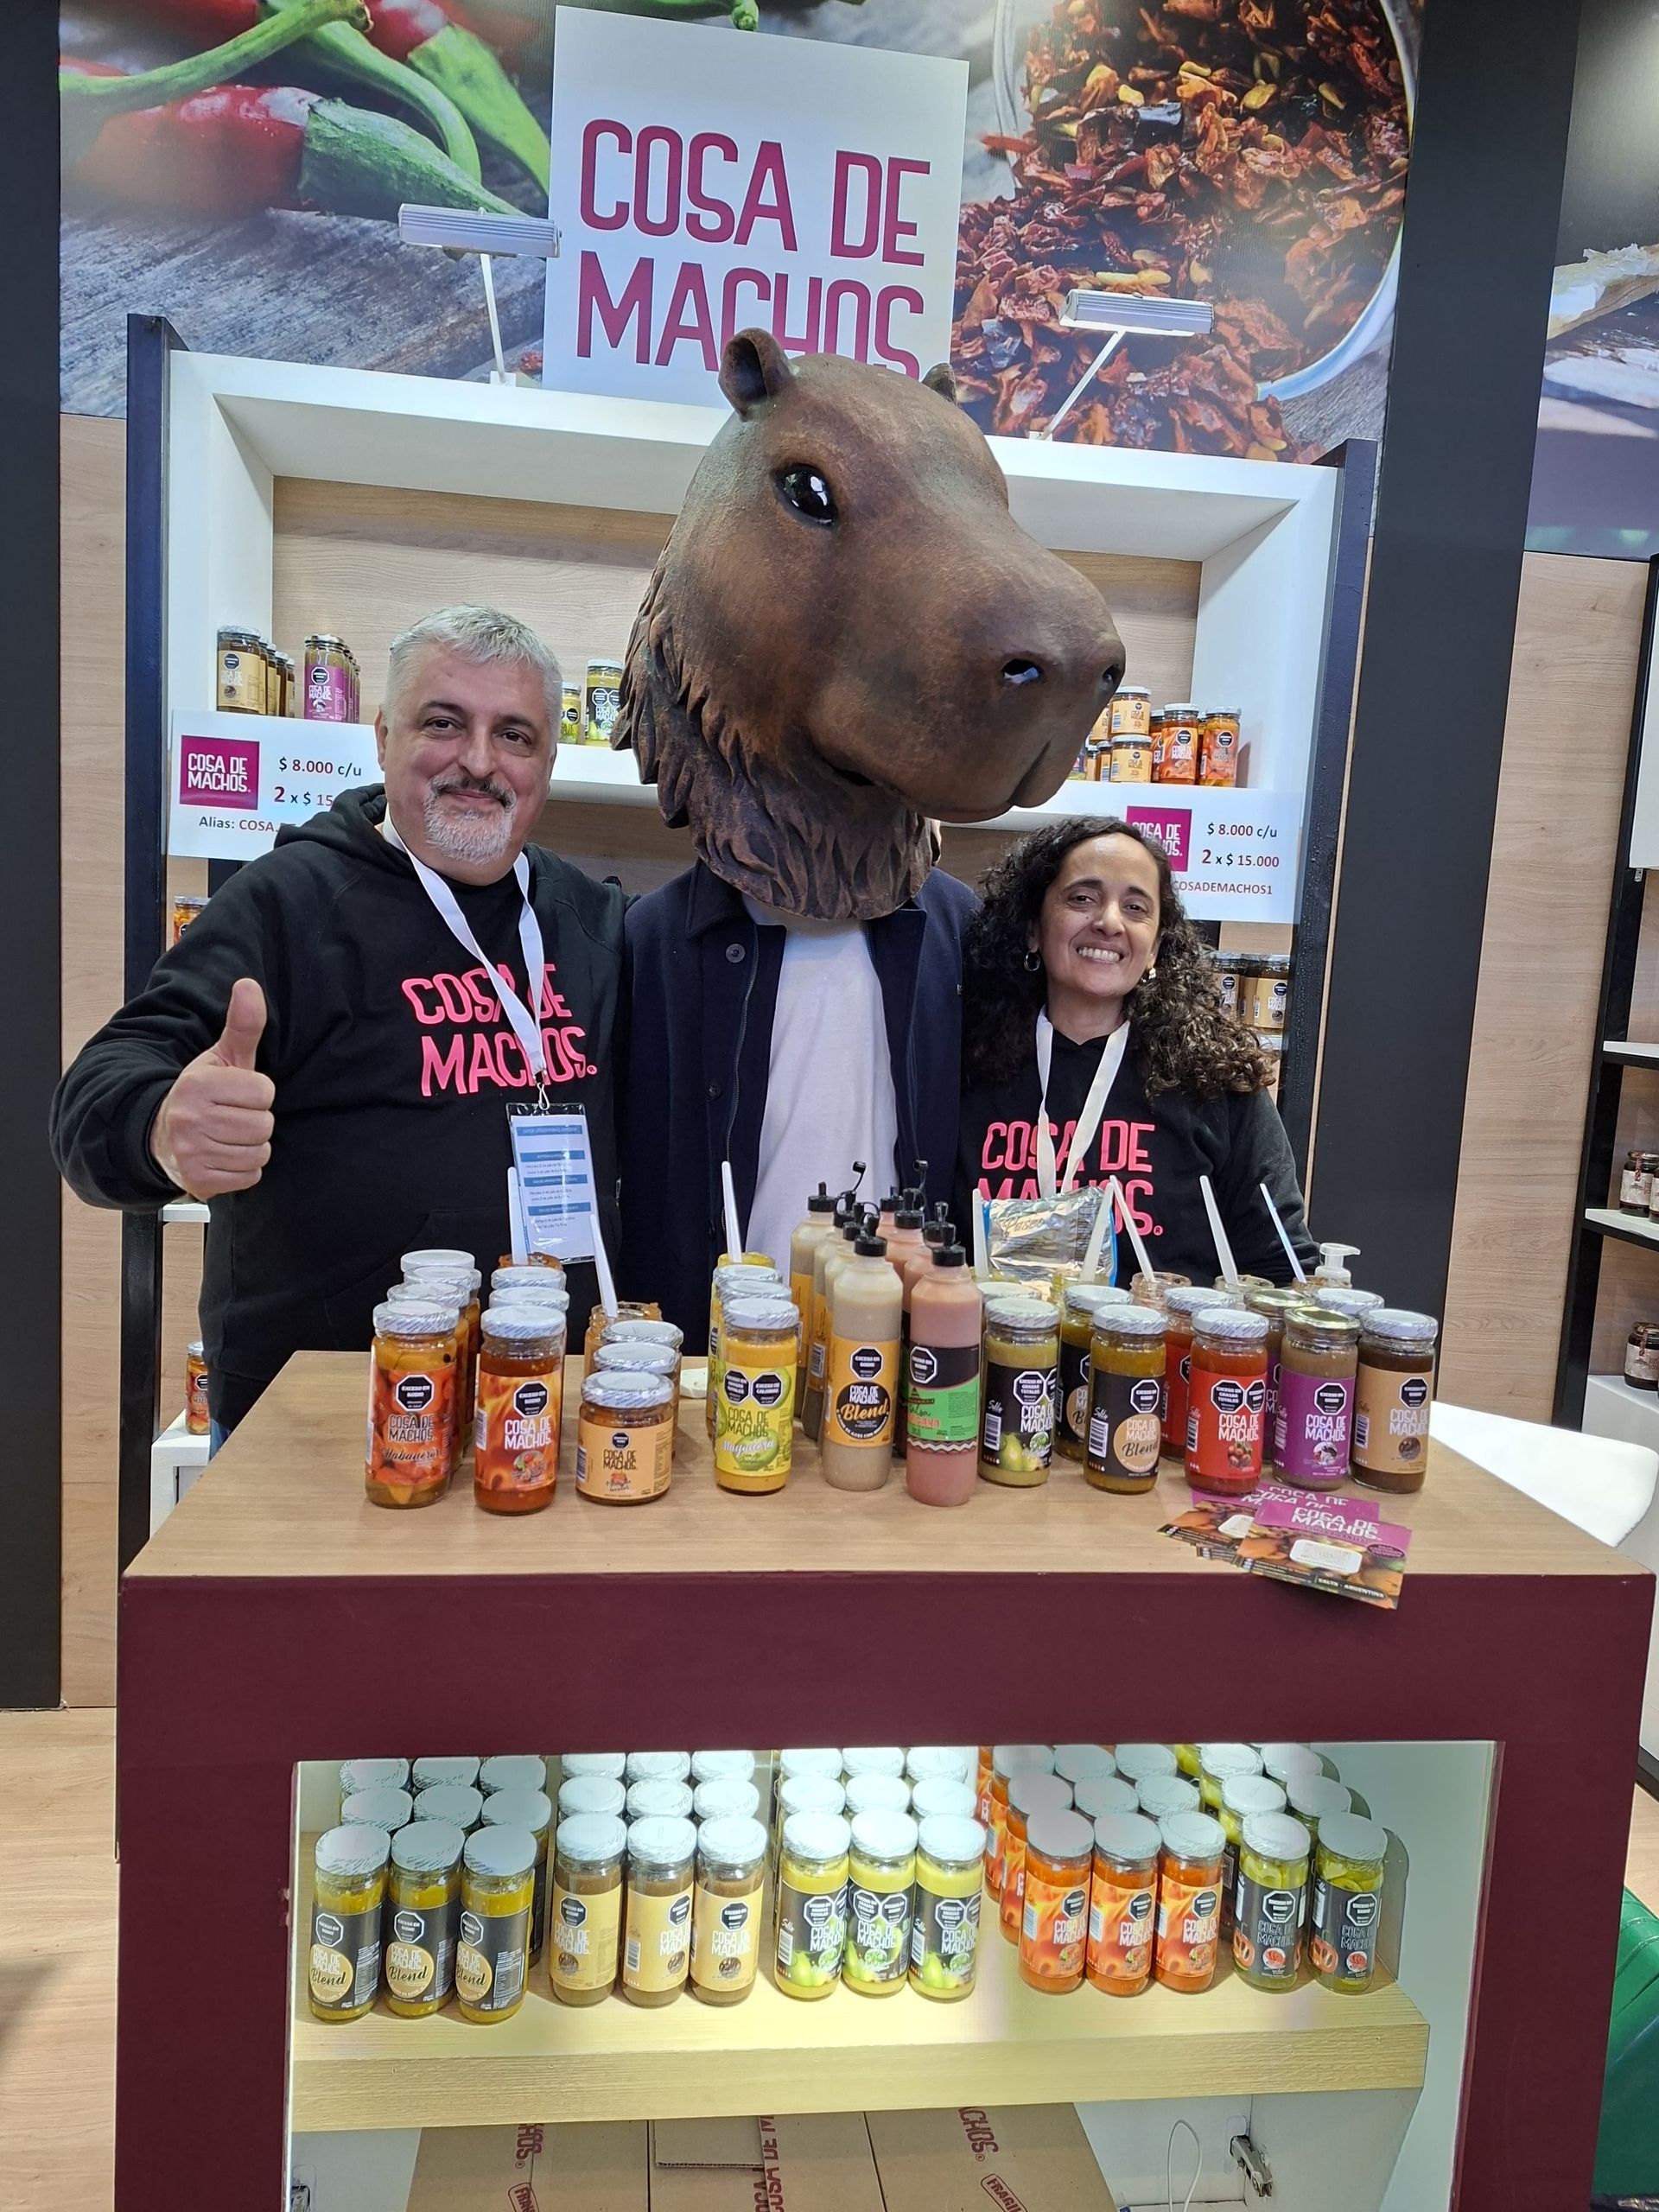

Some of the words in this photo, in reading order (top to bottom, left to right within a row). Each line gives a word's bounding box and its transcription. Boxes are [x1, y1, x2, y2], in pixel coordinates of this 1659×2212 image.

[580, 118, 798, 251] COSA
[830, 149, 931, 267] DE
[576, 250, 925, 382] MACHOS
[188, 753, 225, 775] COSA
[230, 756, 248, 775] DE
[278, 756, 288, 772] $
[292, 759, 334, 774] 8.000
[338, 762, 362, 778] c/u
[188, 772, 248, 792] MACHOS
[273, 785, 285, 803] 2
[290, 793, 298, 804] x
[302, 791, 312, 806] $
[316, 793, 334, 806] 15
[199, 816, 235, 830] Alias:
[238, 819, 278, 832] COSA
[1166, 823, 1181, 840] DE
[1207, 823, 1215, 836] $
[1217, 823, 1253, 836] 8.000
[1256, 825, 1278, 839] c/u
[1201, 849, 1212, 864] 2
[1215, 855, 1223, 865] x
[1225, 854, 1234, 867] $
[1237, 855, 1280, 868] 15.000
[1173, 880, 1273, 895] COSADEMACHOS1
[1099, 1119, 1156, 1173] DE
[728, 1407, 753, 1424] COSA
[756, 1410, 769, 1424] DE
[840, 1398, 888, 1421] Blend
[1020, 1404, 1043, 1421] COSA
[1390, 1408, 1417, 1423] COSA
[389, 1414, 419, 1429] COSA
[421, 1414, 434, 1429] DE
[505, 1419, 535, 1435] COSA
[539, 1415, 553, 1432] DE
[727, 1421, 770, 1437] MACHOS
[1126, 1419, 1147, 1431] COSA
[1218, 1414, 1246, 1428] COSA
[1249, 1414, 1260, 1428] DE
[1306, 1414, 1333, 1428] COSA
[1336, 1415, 1347, 1429] DE
[388, 1427, 434, 1444] MACHOS
[505, 1432, 552, 1451] MACHOS
[1218, 1427, 1260, 1442] MACHOS
[1306, 1427, 1345, 1442] MACHOS
[602, 1449, 625, 1461] COSA
[626, 1449, 637, 1461] DE
[1294, 1507, 1346, 1524] COSA
[1354, 1519, 1380, 1530] DE
[1291, 1514, 1380, 1541] MACHOS
[858, 1919, 881, 1936] COSA
[311, 1967, 346, 1986] Blend
[389, 1966, 428, 1981] Blend
